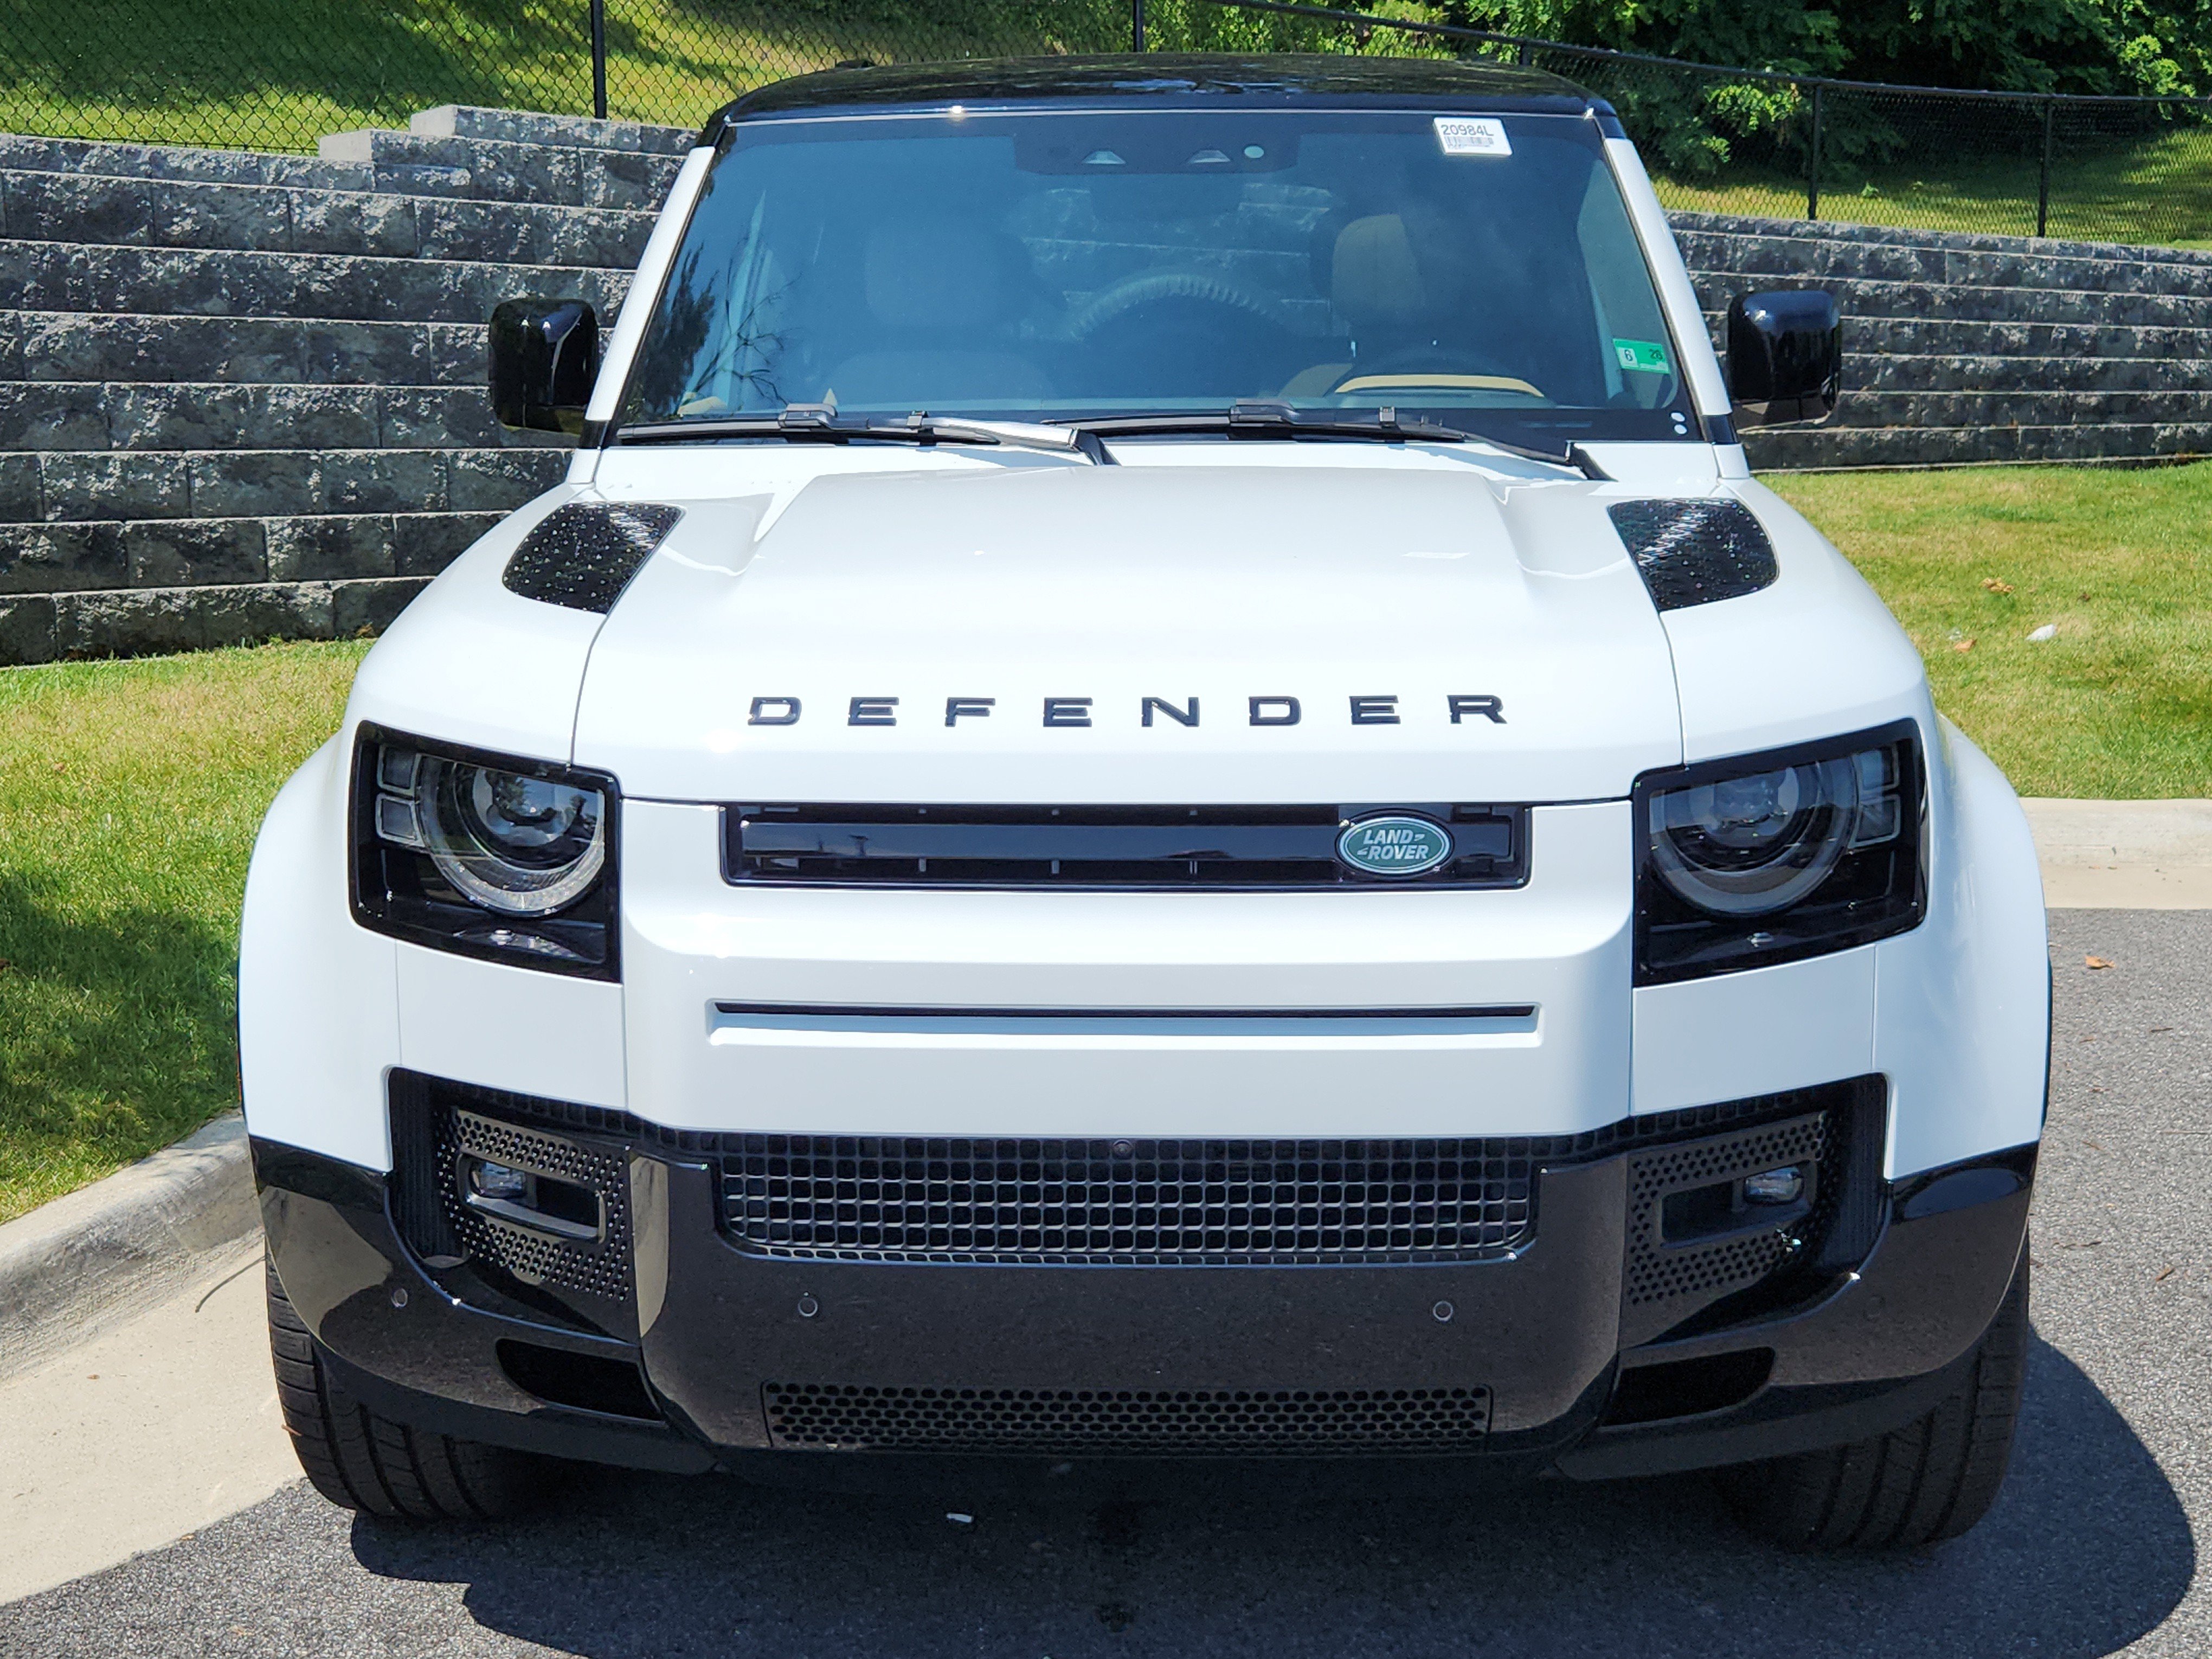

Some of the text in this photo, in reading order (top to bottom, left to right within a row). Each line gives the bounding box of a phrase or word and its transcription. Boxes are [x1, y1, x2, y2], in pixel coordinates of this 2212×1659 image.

[1441, 125, 1494, 137] 20984L
[1624, 349, 1633, 362] 6
[748, 696, 1507, 727] DEFENDER
[1363, 829, 1413, 845] LAND
[1367, 845, 1429, 859] ROVER
